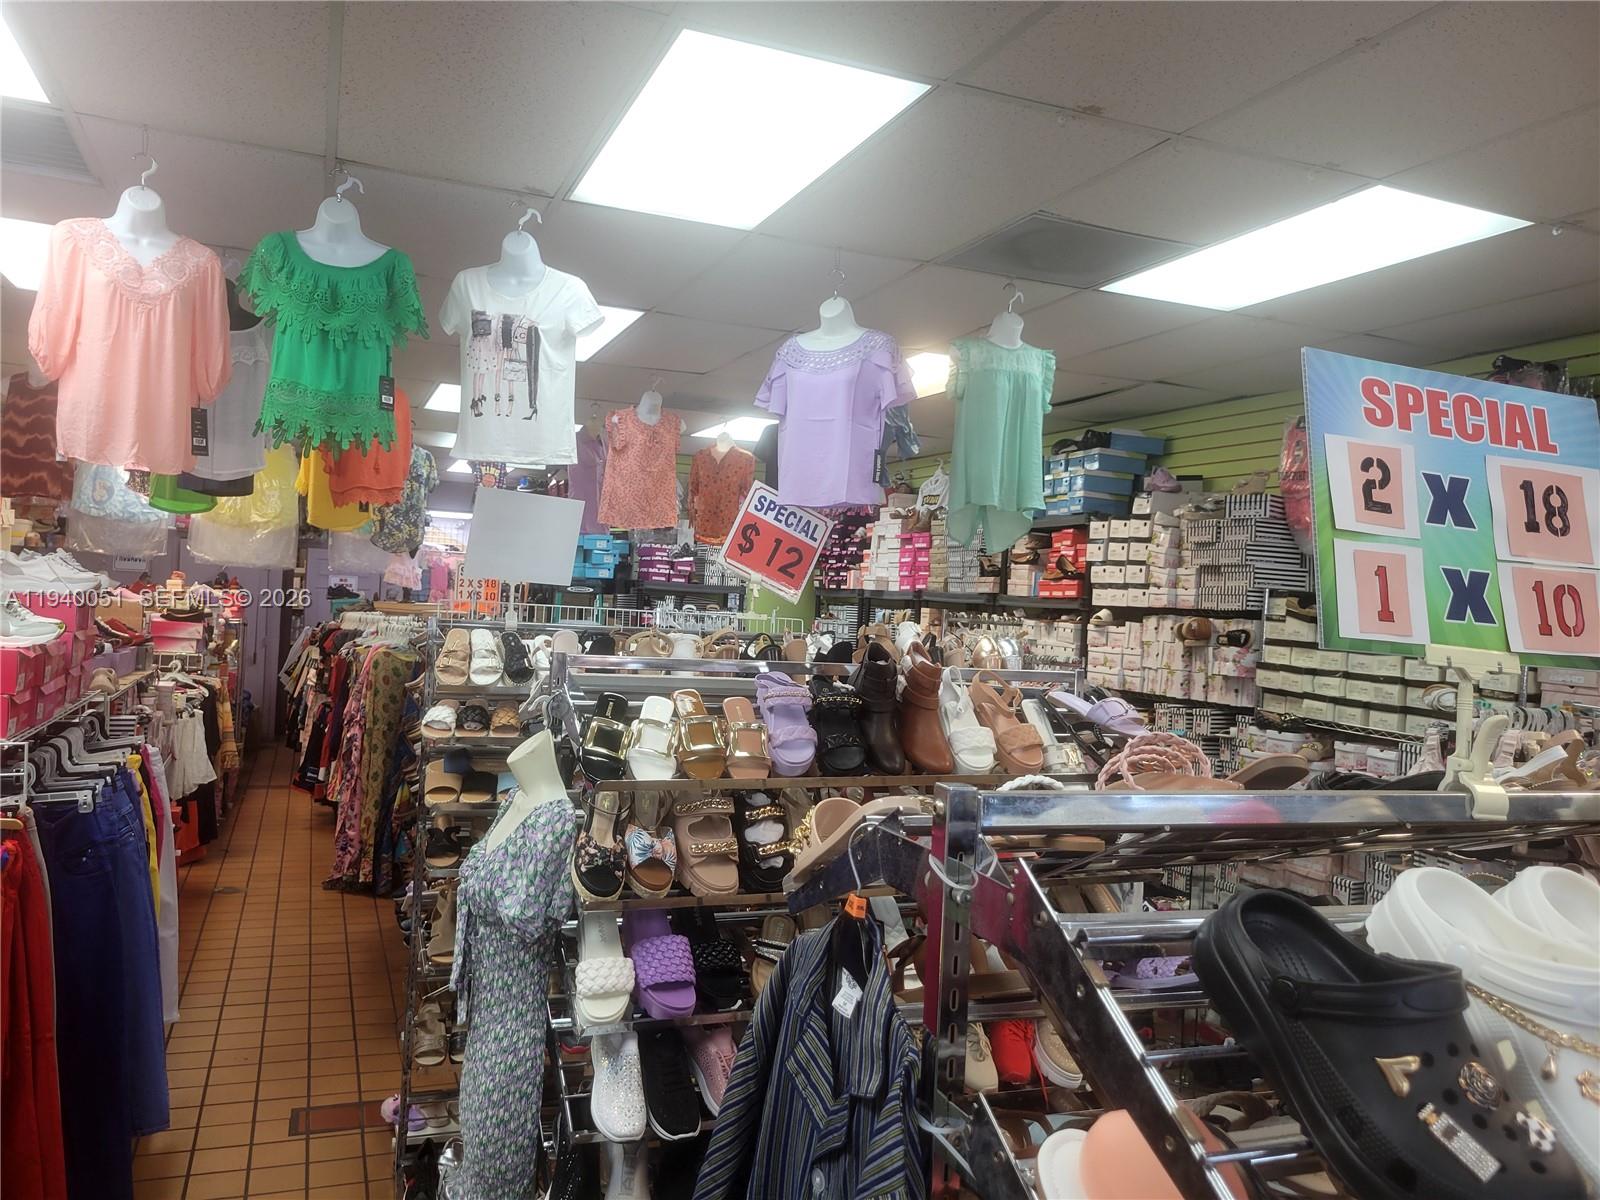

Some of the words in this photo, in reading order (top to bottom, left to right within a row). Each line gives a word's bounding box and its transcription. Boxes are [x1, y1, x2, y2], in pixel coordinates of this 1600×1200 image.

[1360, 376, 1560, 455] SPECIAL
[754, 494, 819, 543] SPECIAL
[1360, 456, 1393, 515] 2
[1519, 479, 1570, 538] 18
[766, 537, 804, 580] 12
[1374, 565, 1396, 623] 1
[1532, 580, 1586, 638] 10
